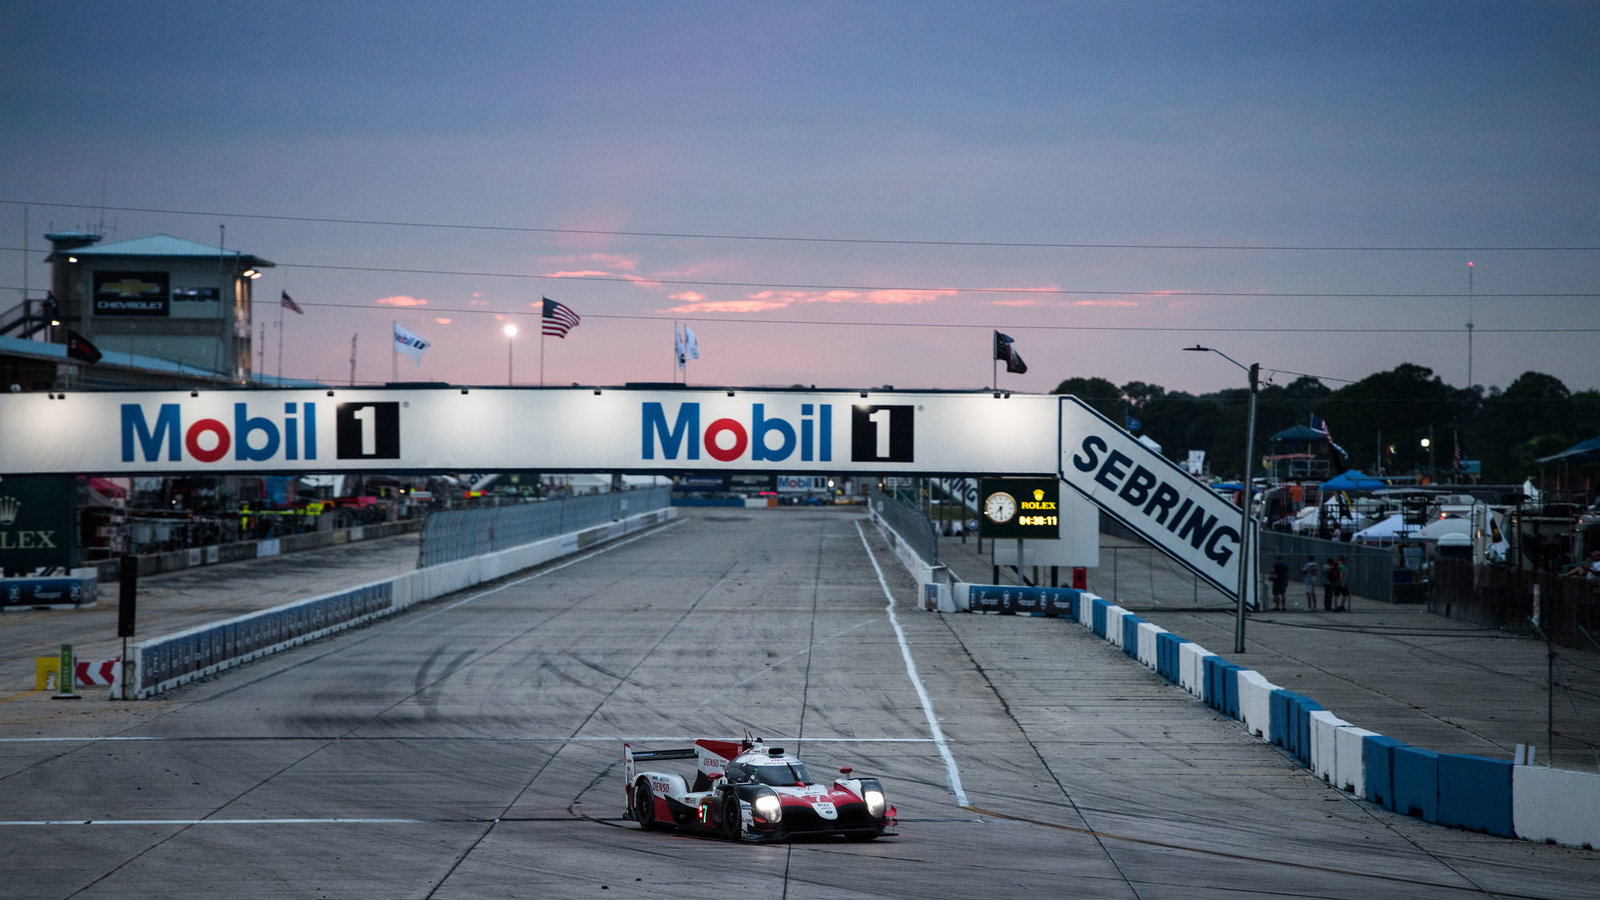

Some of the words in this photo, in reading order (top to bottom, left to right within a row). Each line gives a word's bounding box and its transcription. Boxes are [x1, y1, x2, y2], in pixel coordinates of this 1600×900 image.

[97, 301, 163, 309] CHEVROLET
[120, 402, 317, 462] Mobil
[641, 402, 832, 462] Mobil
[778, 477, 812, 488] Mobil
[1021, 501, 1056, 510] ROLEX
[1073, 435, 1241, 567] SEBRING
[703, 757, 720, 768] DENSO
[652, 781, 670, 793] DENSO
[702, 804, 708, 823] 7
